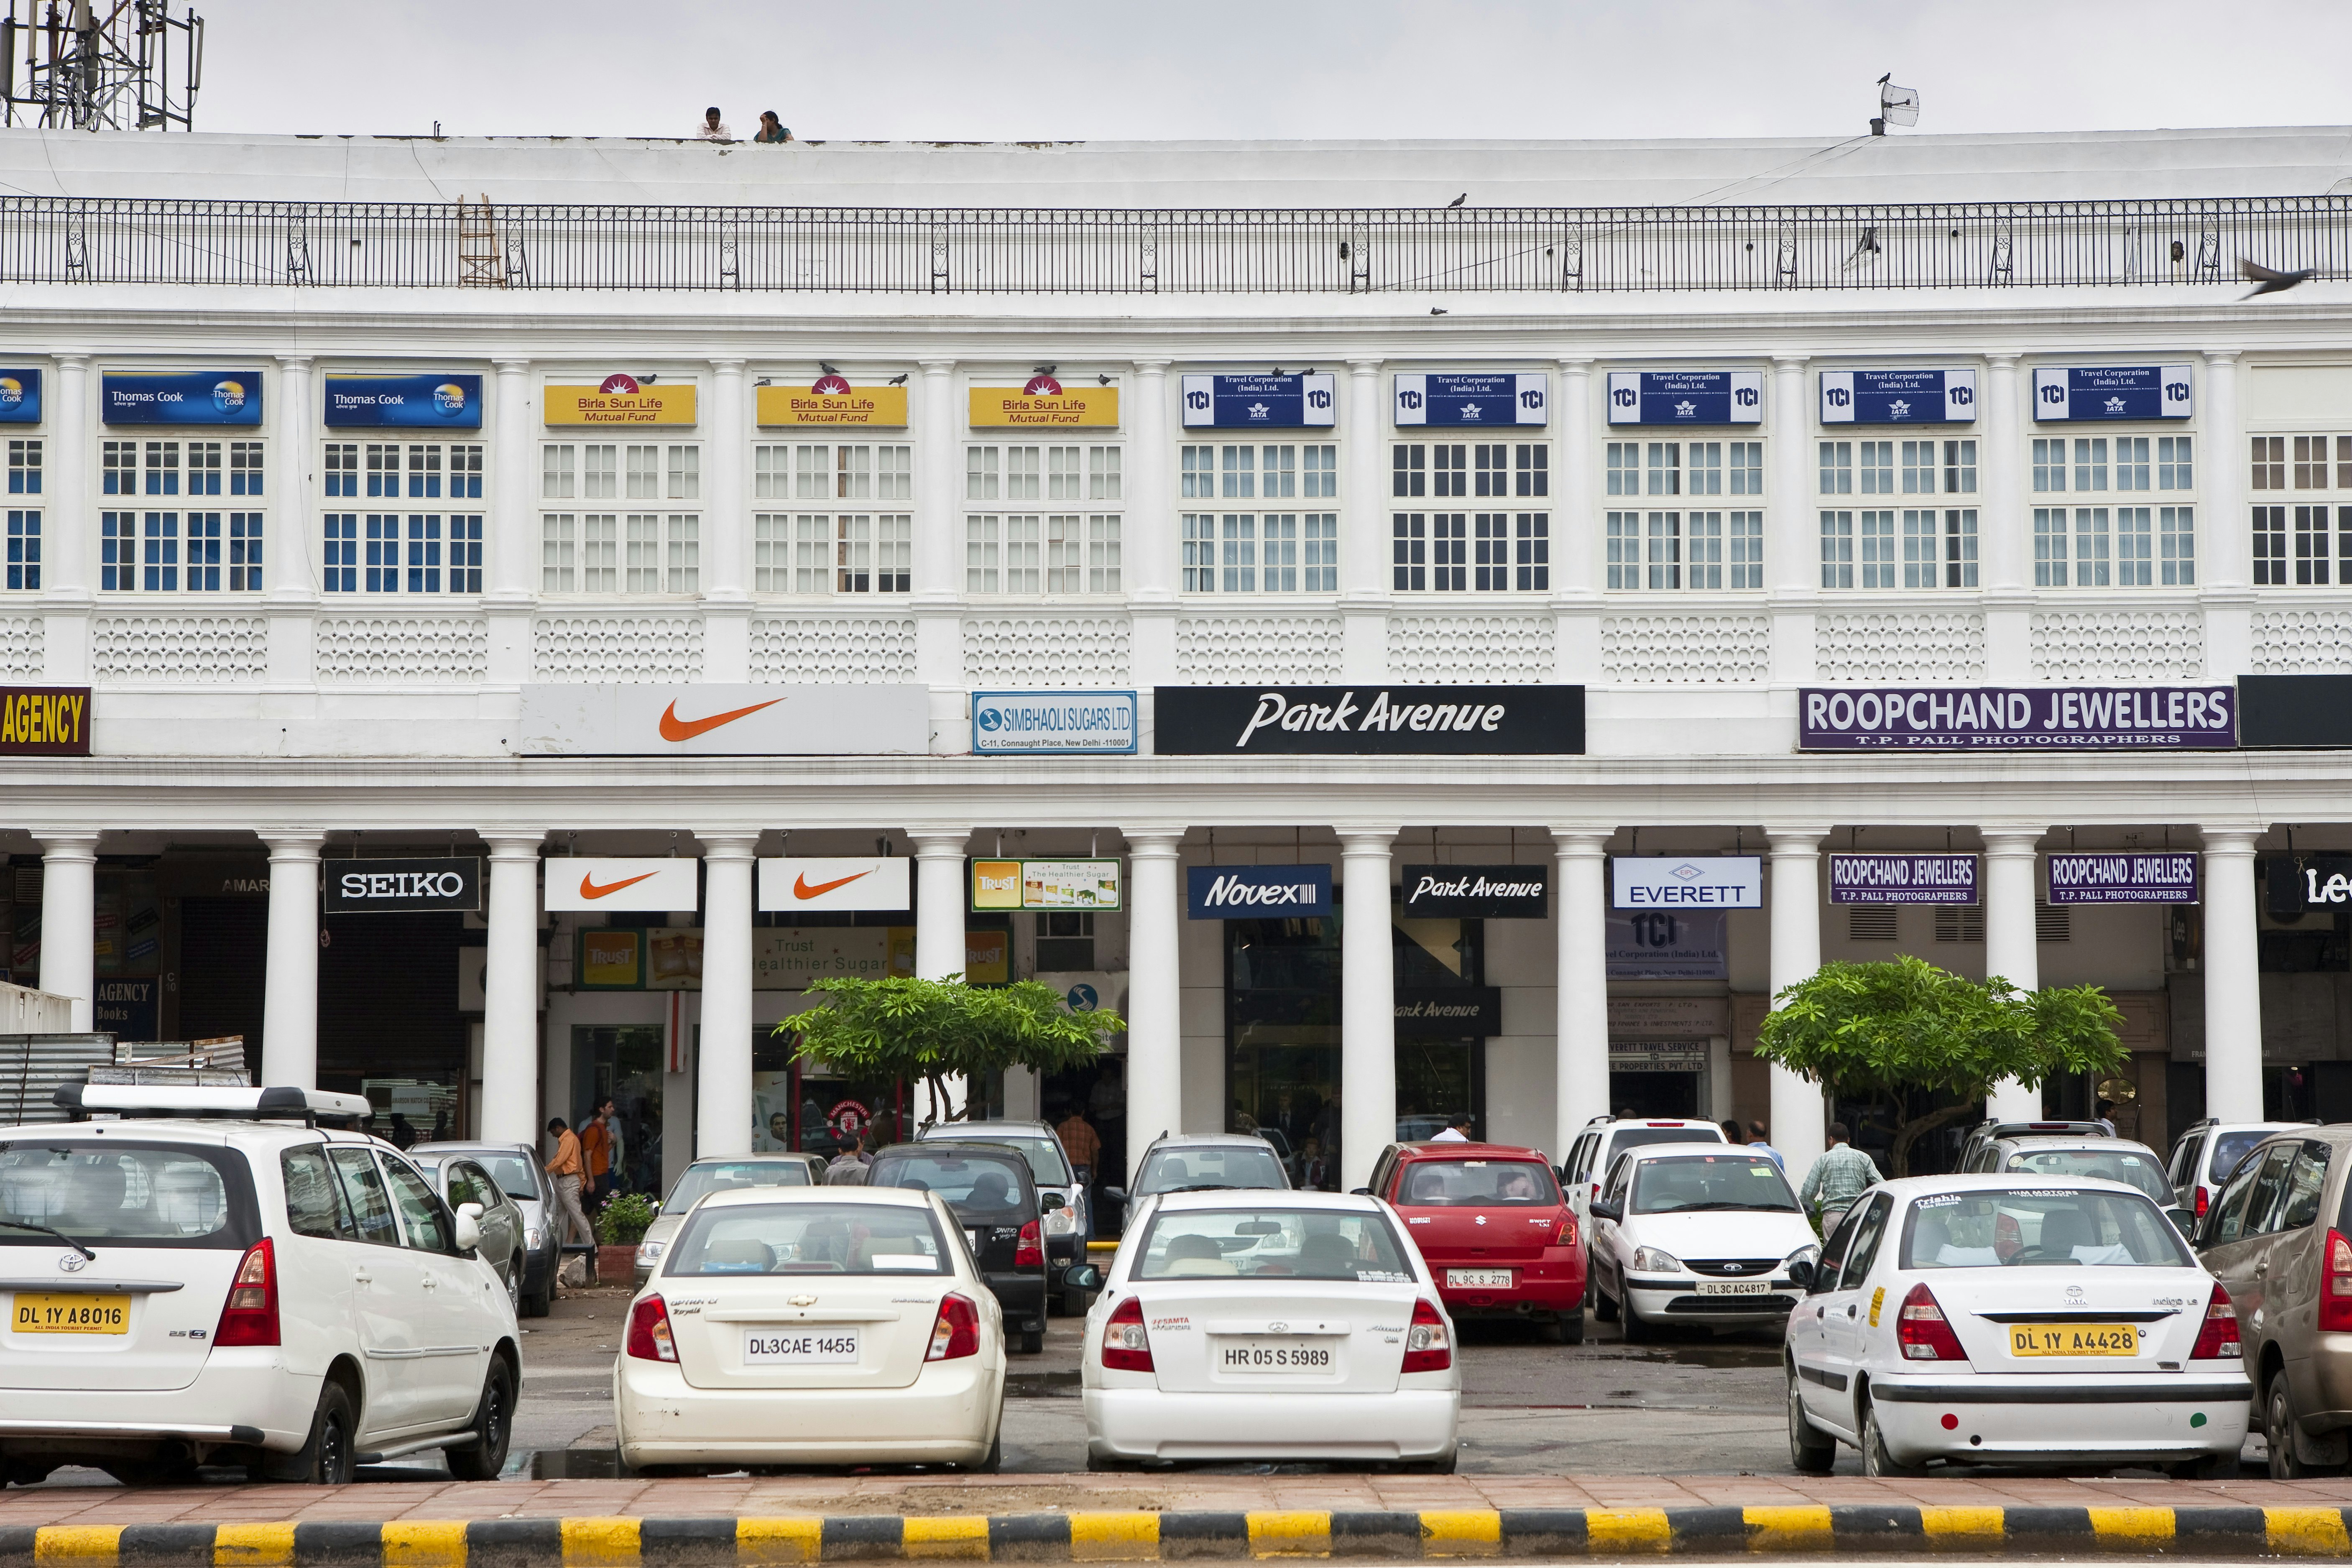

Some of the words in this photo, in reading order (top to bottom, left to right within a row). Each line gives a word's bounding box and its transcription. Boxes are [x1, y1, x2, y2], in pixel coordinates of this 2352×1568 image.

[1249, 376, 1292, 384] Corporation
[1461, 376, 1505, 385] Corporation
[1676, 373, 1720, 382] Corporation
[1889, 373, 1933, 381] Corporation
[112, 391, 154, 401] Thomas
[158, 392, 183, 402] Cook
[334, 394, 375, 404] Thomas
[378, 395, 404, 404] Cook
[1308, 390, 1331, 409] TCI
[1520, 390, 1543, 409] TCI
[1613, 388, 1636, 407] TCI
[1735, 388, 1758, 406] TCI
[1826, 388, 1850, 407] TCI
[1949, 386, 1973, 405] TCI
[2040, 385, 2064, 404] TCI
[2165, 382, 2189, 401] TCI
[578, 398, 605, 408] Birla
[610, 398, 635, 408] Sun
[639, 398, 663, 408] Life
[791, 399, 818, 409] Birla
[822, 398, 847, 409] Sun
[851, 399, 874, 409] Life
[1003, 400, 1029, 410] Birla
[1034, 399, 1059, 410] Sun
[1063, 400, 1086, 410] Life
[1187, 391, 1210, 410] TCI
[1399, 391, 1422, 410] TCI
[584, 413, 626, 421] Mutual
[628, 413, 656, 421] Fund
[797, 413, 838, 421] Mutual
[840, 413, 868, 422] Fund
[1009, 414, 1050, 422] Mutual
[1052, 414, 1080, 423] Fund
[1, 694, 84, 743] AGENCY
[1236, 691, 1358, 747] Park
[1359, 691, 1505, 733] Avenue
[1807, 692, 2032, 731] ROOPCHAND
[2043, 691, 2229, 730] JEWELLERS
[1004, 707, 1066, 732] SIMBHAOLI
[1068, 707, 1110, 731] SUGARS
[1112, 707, 1131, 731] LTD.
[981, 740, 999, 748] C-11,
[1001, 739, 1041, 748] Connaught
[1042, 739, 1064, 748] Place,
[1856, 736, 1899, 746] T.P.
[1907, 736, 1964, 745] PALL
[1971, 734, 2181, 745] PHOTOGRAPHERS
[1835, 859, 1909, 886] ROOPCHAND
[1912, 859, 1973, 886] JEWELLERS
[2053, 858, 2128, 885] ROOPCHAND
[2131, 857, 2193, 884] JEWELLERS
[341, 872, 464, 898] SEIKO
[979, 876, 1017, 890] TRUST
[1204, 875, 1300, 907] Novex
[1409, 876, 1470, 904] Park
[1469, 876, 1543, 897] Avenue
[2306, 868, 2352, 903] Le
[1630, 886, 1746, 903] EVERETT
[1841, 891, 1859, 901] T.P.
[1861, 892, 1884, 901] PALL
[1886, 891, 1968, 901] PHOTOGRAPHERS
[2060, 891, 2077, 900] T.P.
[2080, 891, 2103, 900] PALL
[2105, 891, 2188, 900] PHOTOGRAPHERS
[1632, 912, 1677, 948] TCI
[2173, 916, 2185, 942] Lee
[775, 939, 814, 952] Trust
[589, 948, 633, 965] TRUST
[1619, 950, 1669, 959] Corporation
[1671, 950, 1699, 959] (India)
[835, 957, 888, 973] Sugar
[167, 972, 175, 983] C
[97, 983, 150, 1002] AGENCY
[166, 983, 176, 992] 10
[97, 1006, 128, 1021] Books
[1394, 1001, 1424, 1017] ark
[1423, 1001, 1480, 1017] Avenue
[1609, 1042, 1637, 1052] VERETT
[1639, 1042, 1666, 1051] TRAVEL
[1668, 1042, 1700, 1051] SERVICE
[1619, 1062, 1666, 1070] PROPERTIES
[1669, 1062, 1685, 1070] PVT.
[1688, 1062, 1706, 1070] LTD.
[830, 1100, 868, 1117] MANCHESTER
[1915, 1195, 1962, 1207] Trishla
[1448, 1275, 1460, 1285] DL
[1463, 1275, 1474, 1285] 9C
[1479, 1275, 1484, 1285] S
[1491, 1275, 1510, 1285] 2778
[2063, 1297, 2089, 1306] TATA
[2151, 1296, 2183, 1308] Indigo
[19, 1307, 40, 1324] DL
[46, 1307, 64, 1324] 1Y
[68, 1307, 122, 1325] A8016
[750, 1338, 812, 1355] DL3CAE
[817, 1338, 856, 1354] 1455
[2015, 1333, 2039, 1350] DL
[2043, 1333, 2062, 1349] 1Y
[2073, 1332, 2133, 1350] A4428
[1225, 1349, 1250, 1366] HR
[1254, 1349, 1273, 1366] 05
[1276, 1349, 1287, 1365] S
[1291, 1349, 1330, 1366] 5989
